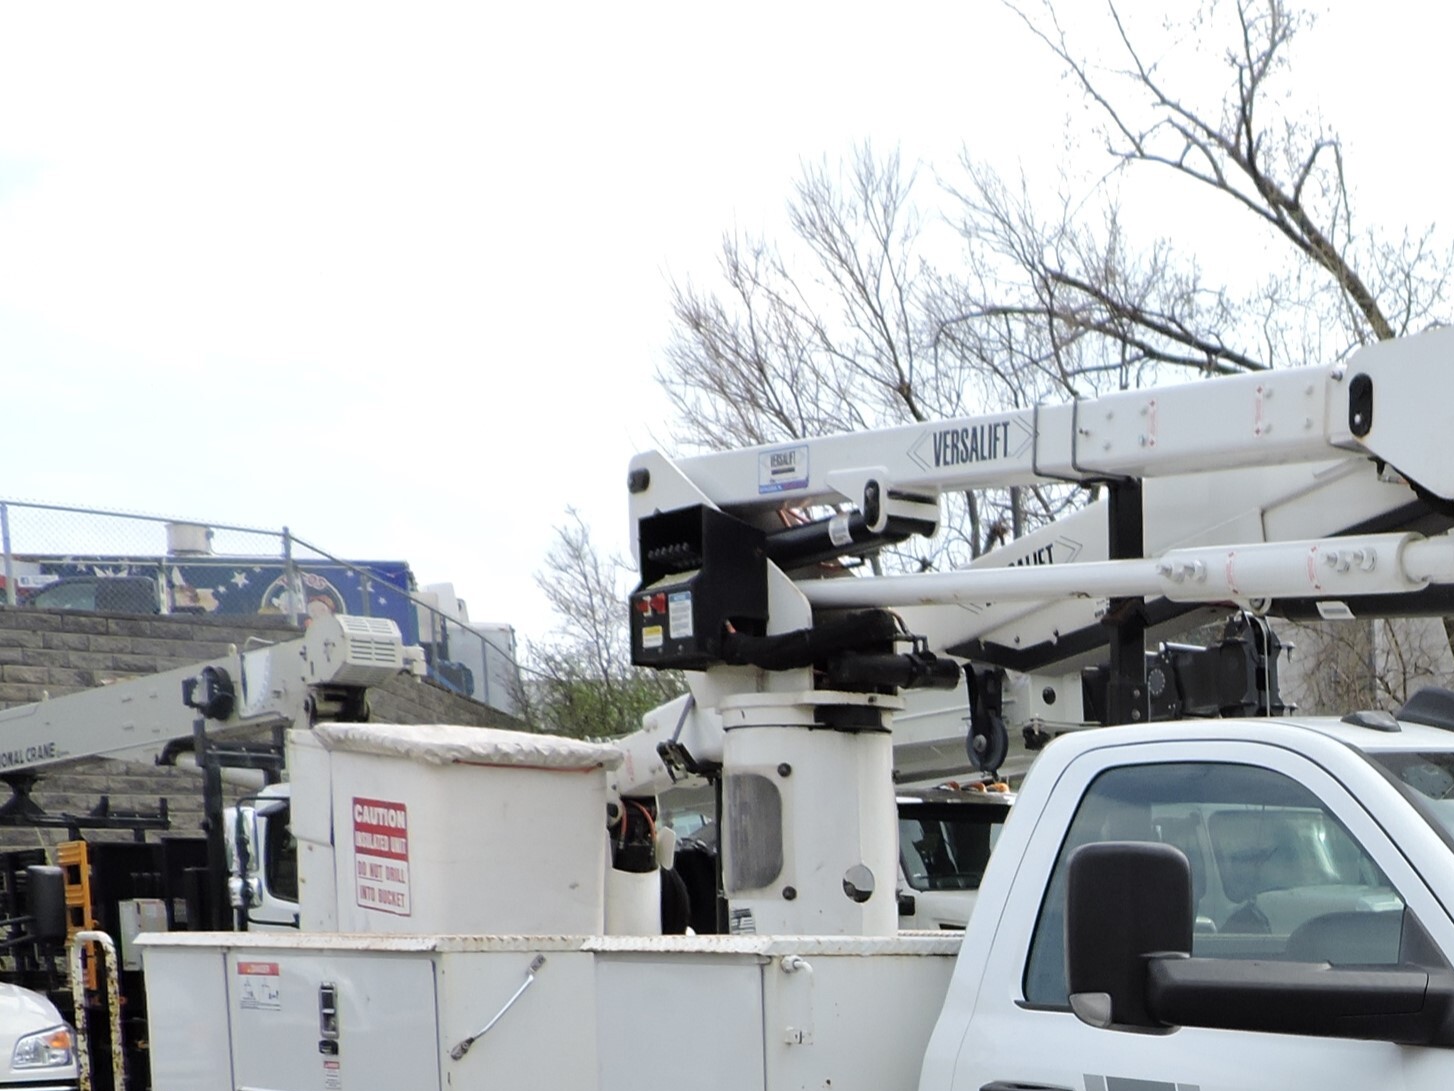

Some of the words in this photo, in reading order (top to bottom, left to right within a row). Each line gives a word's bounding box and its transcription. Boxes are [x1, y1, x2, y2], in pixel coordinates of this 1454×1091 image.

[933, 421, 1010, 467] VERSALIFT
[26, 742, 55, 762] CRANE
[355, 804, 406, 829] CAUTION
[391, 837, 407, 854] UNIT
[358, 860, 368, 876] DO
[369, 863, 383, 879] NOT
[385, 865, 406, 884] DRILL
[359, 885, 376, 902] INTO
[377, 889, 406, 908] BUCKET
